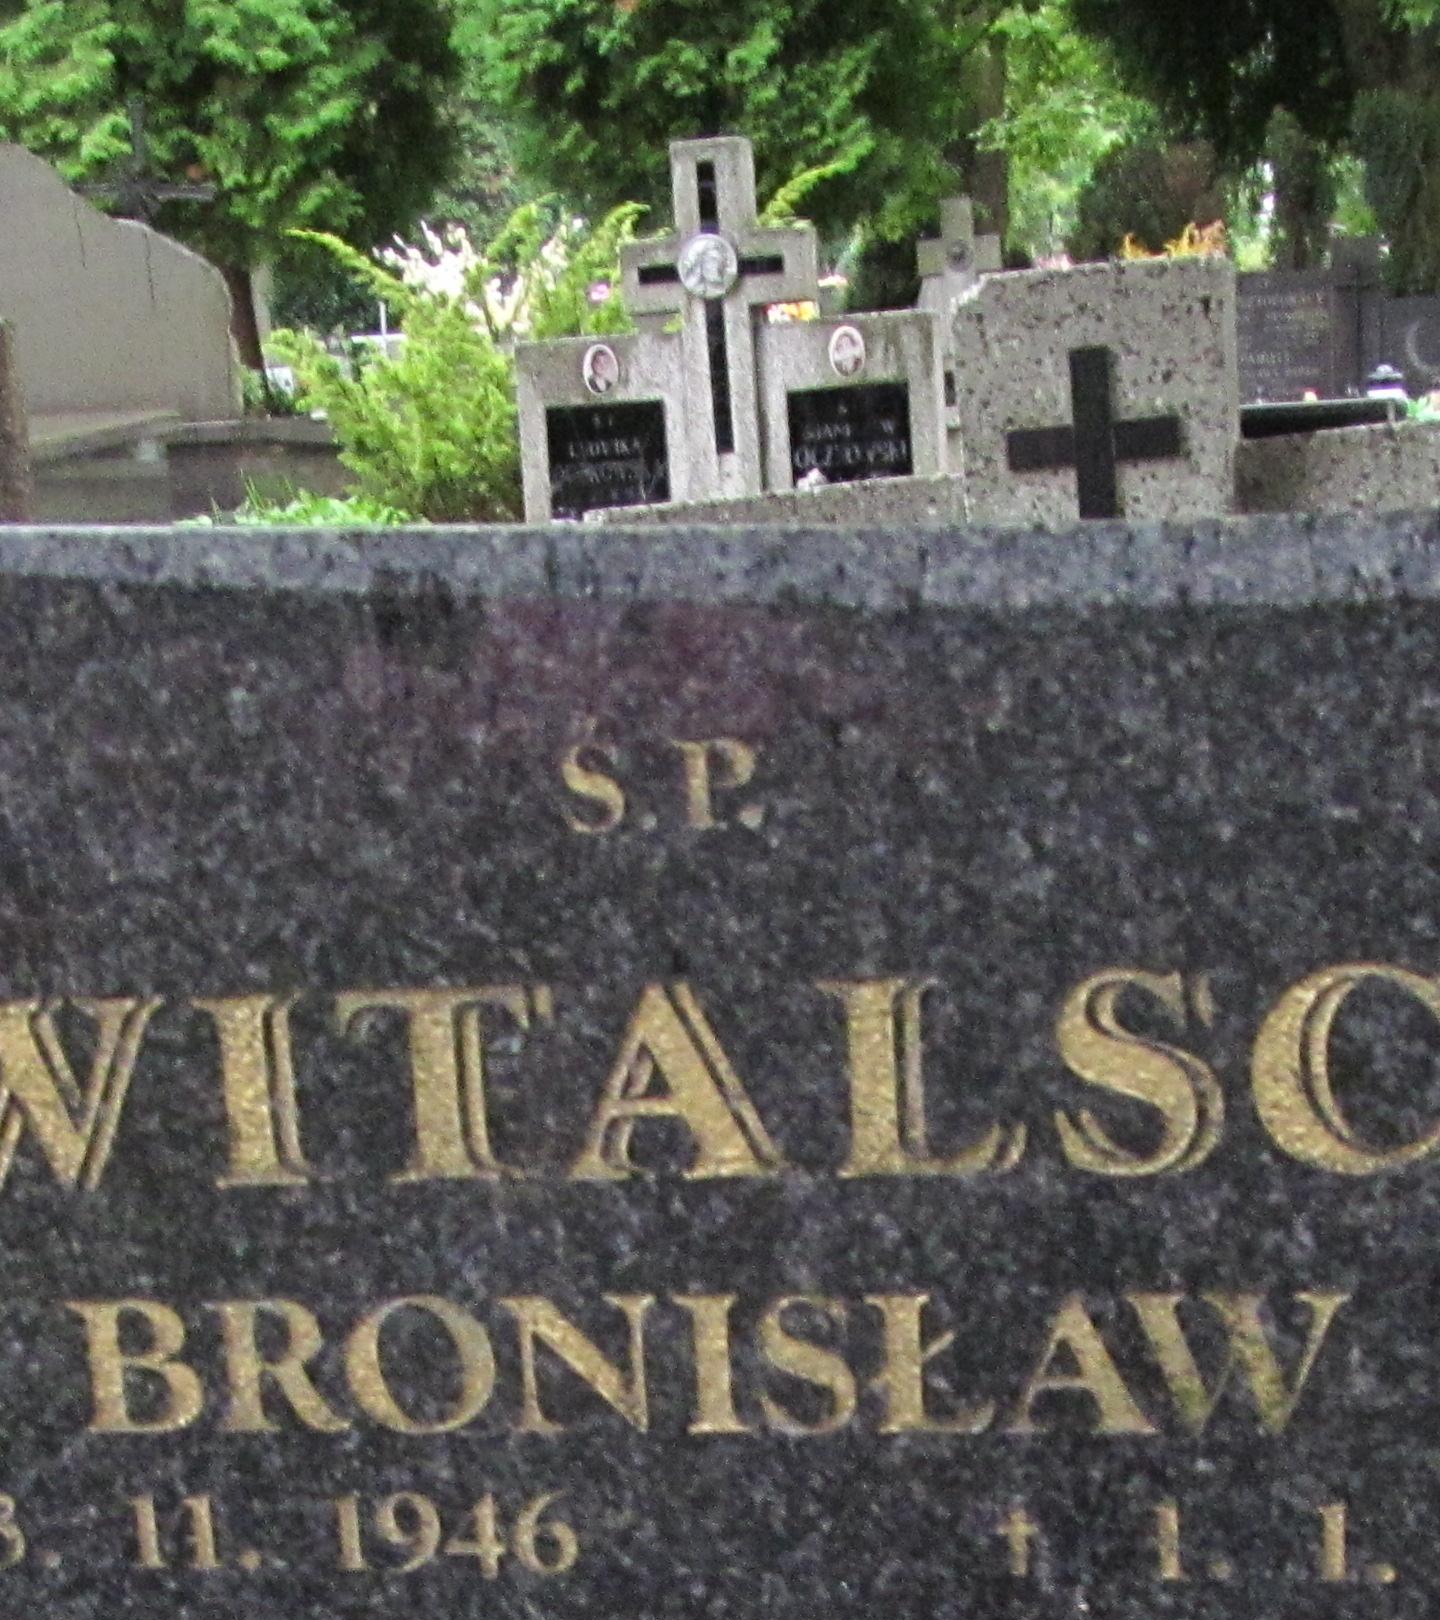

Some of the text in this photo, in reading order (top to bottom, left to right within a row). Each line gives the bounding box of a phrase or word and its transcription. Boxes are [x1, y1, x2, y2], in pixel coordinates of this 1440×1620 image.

[63, 1292, 1351, 1437] BRONISŁAW
[128, 1490, 262, 1571] 11.
[333, 1489, 580, 1579] 1946
[1156, 1500, 1232, 1583] 1.
[1316, 1501, 1398, 1584] 1.
